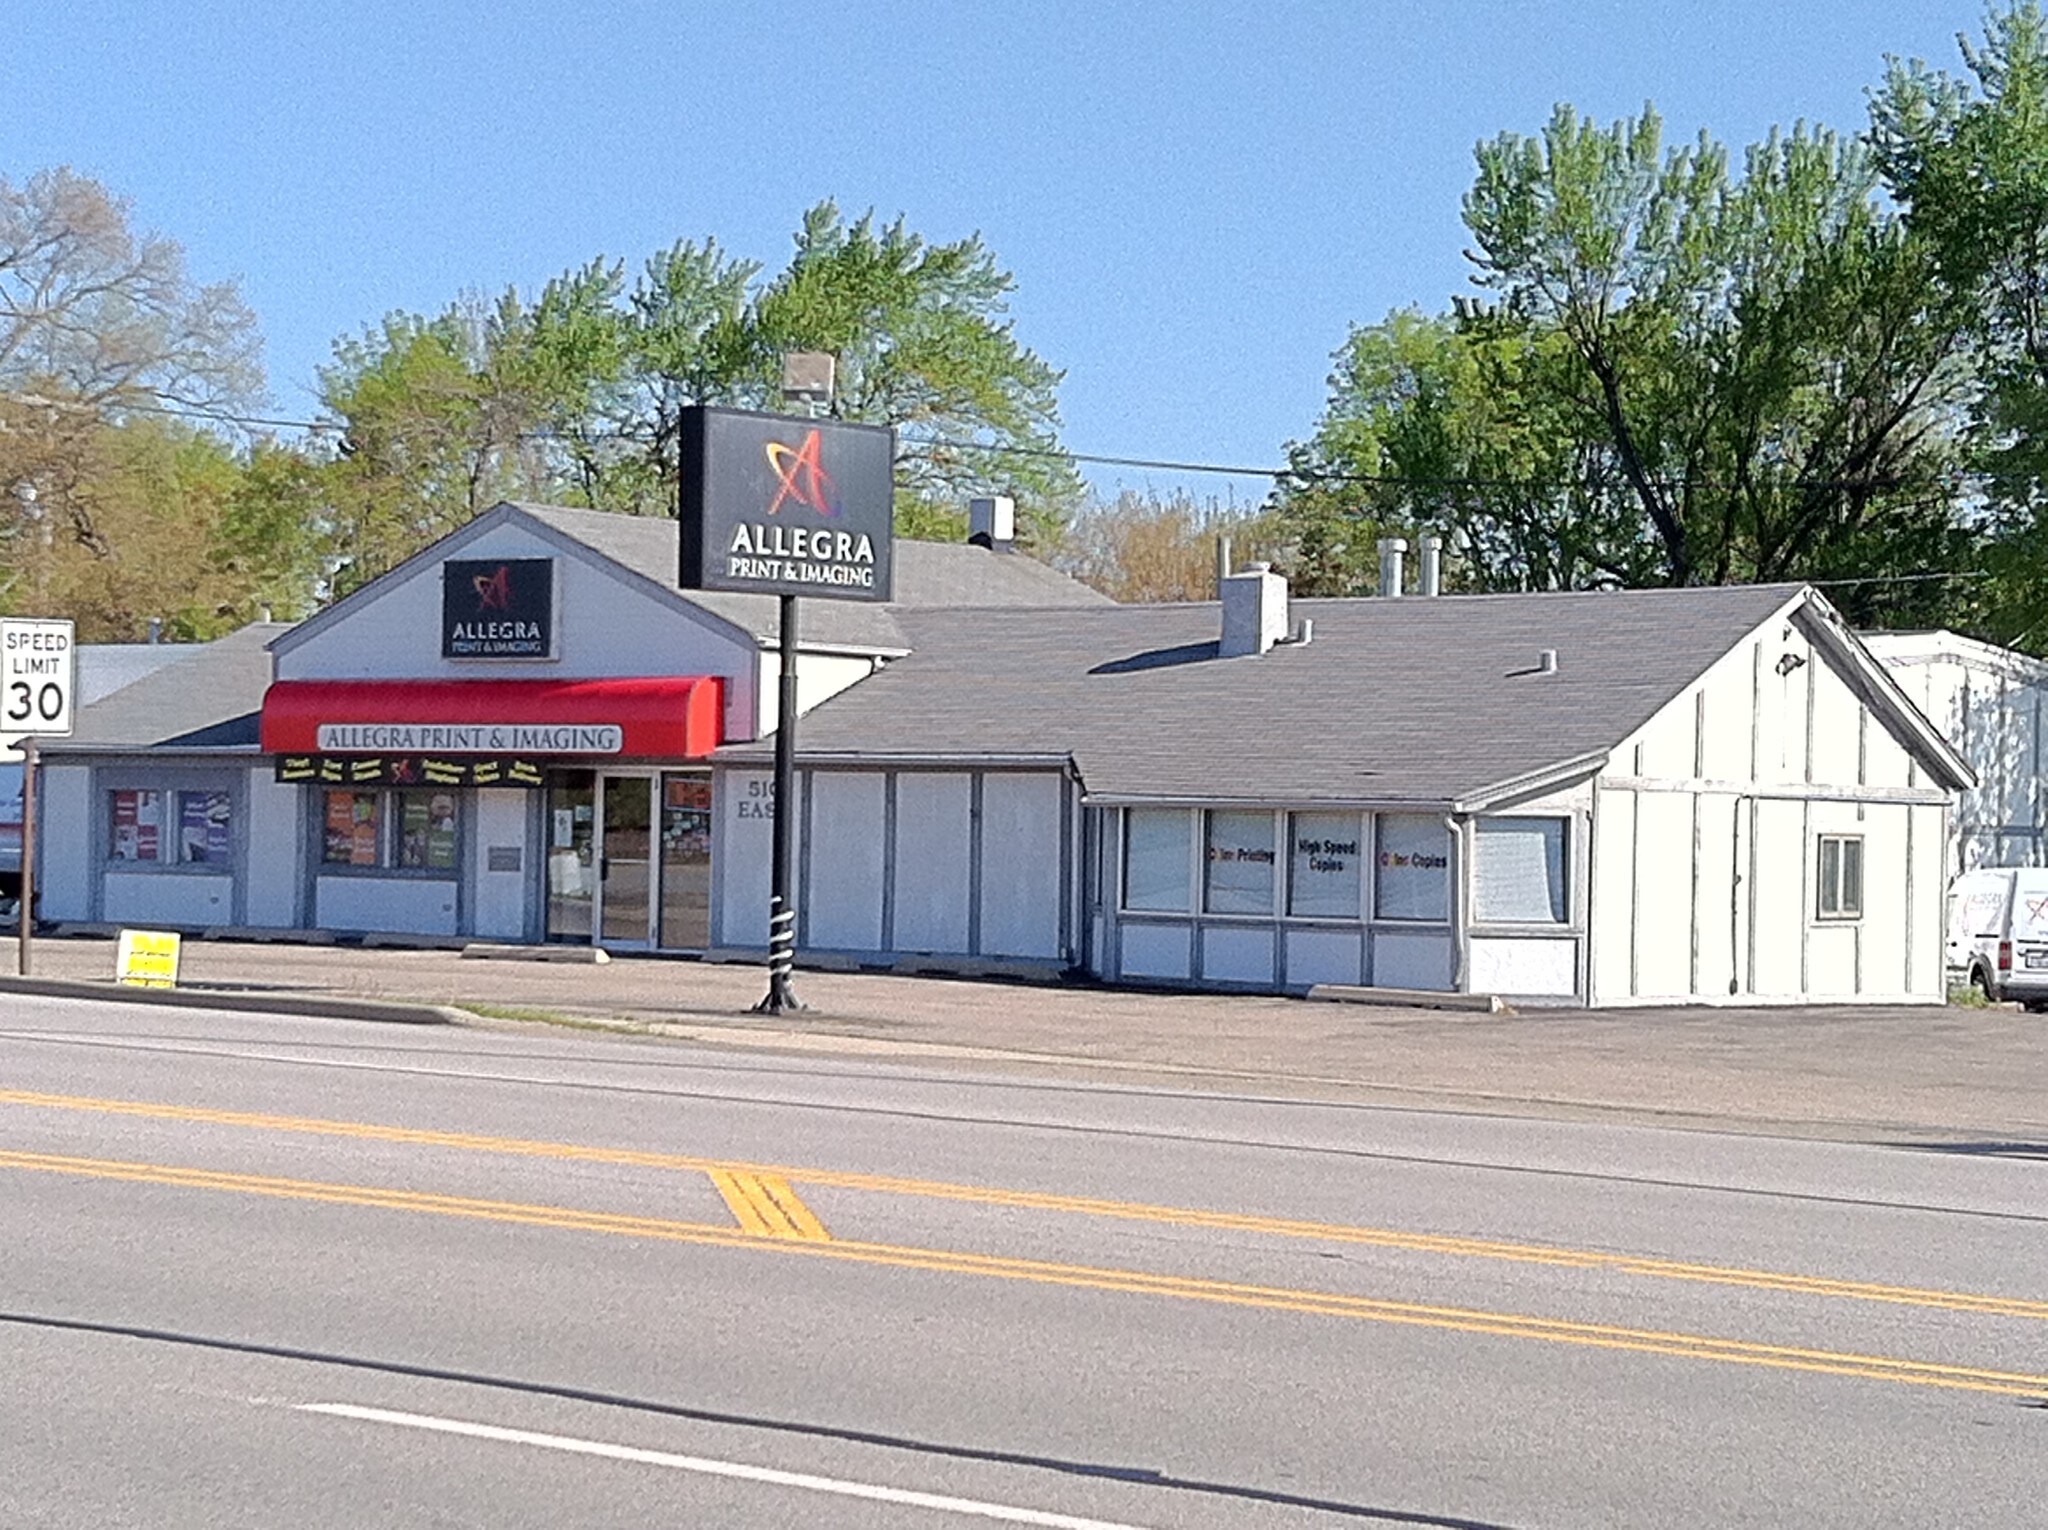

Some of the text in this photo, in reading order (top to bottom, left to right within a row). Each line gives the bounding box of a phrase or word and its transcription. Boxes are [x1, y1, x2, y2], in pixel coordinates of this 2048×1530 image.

[731, 522, 875, 564] ALLEGRA
[730, 557, 874, 588] PRINT & IMAGING
[453, 622, 541, 639] ALLEGRA
[6, 632, 68, 651] SPEED
[13, 657, 60, 674] LIMIT
[8, 681, 63, 721] 30
[326, 727, 614, 749] ALLEGRA PRINT & IMAGING
[738, 801, 775, 818] EAS
[1299, 839, 1357, 855] High Speed
[1309, 856, 1344, 872] Copies
[1411, 852, 1448, 868] Copies
